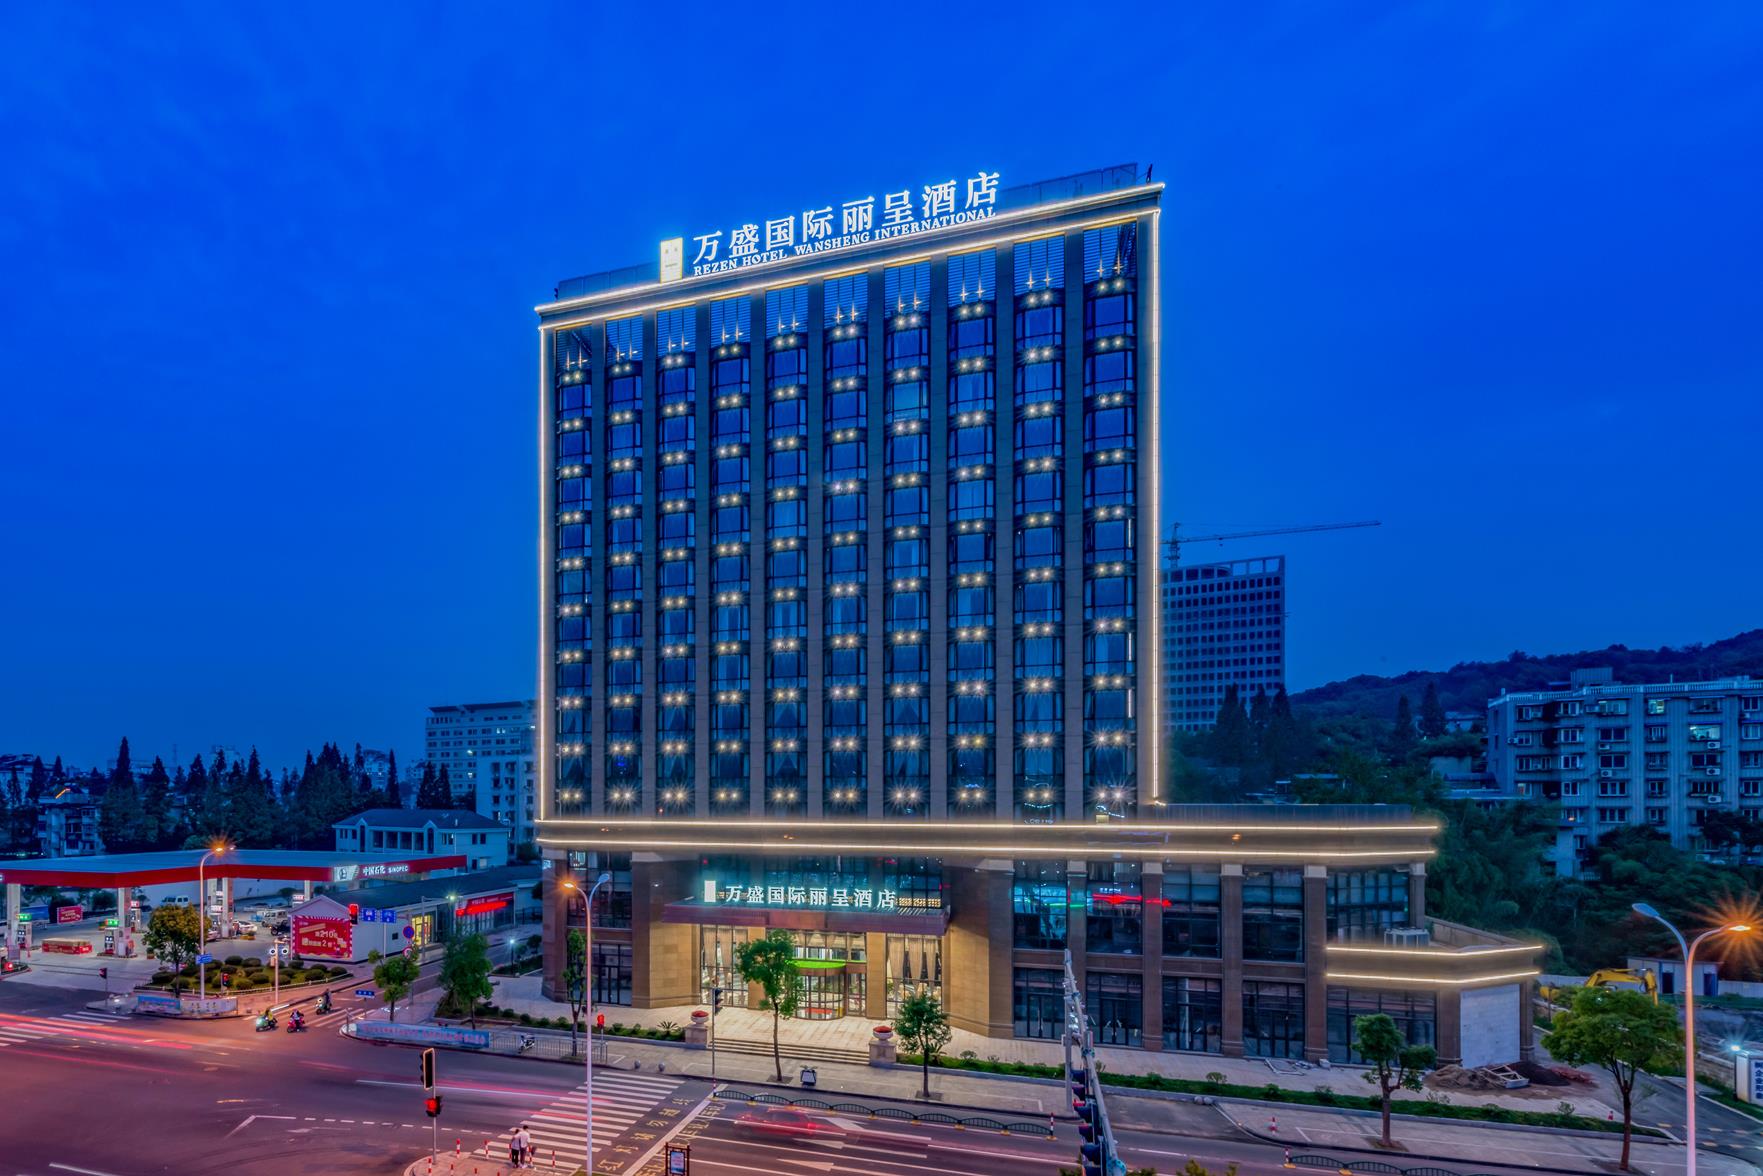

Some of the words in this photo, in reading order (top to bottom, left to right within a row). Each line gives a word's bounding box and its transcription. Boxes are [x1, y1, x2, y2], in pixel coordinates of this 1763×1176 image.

[693, 171, 1000, 265] 万盛国际丽呈酒店
[693, 258, 738, 276] REZEN
[742, 249, 788, 267] HOTEL
[794, 231, 871, 256] WANSHENG
[875, 206, 996, 241] INTERNATIONAL
[725, 885, 898, 909] 万盛国际丽呈酒店
